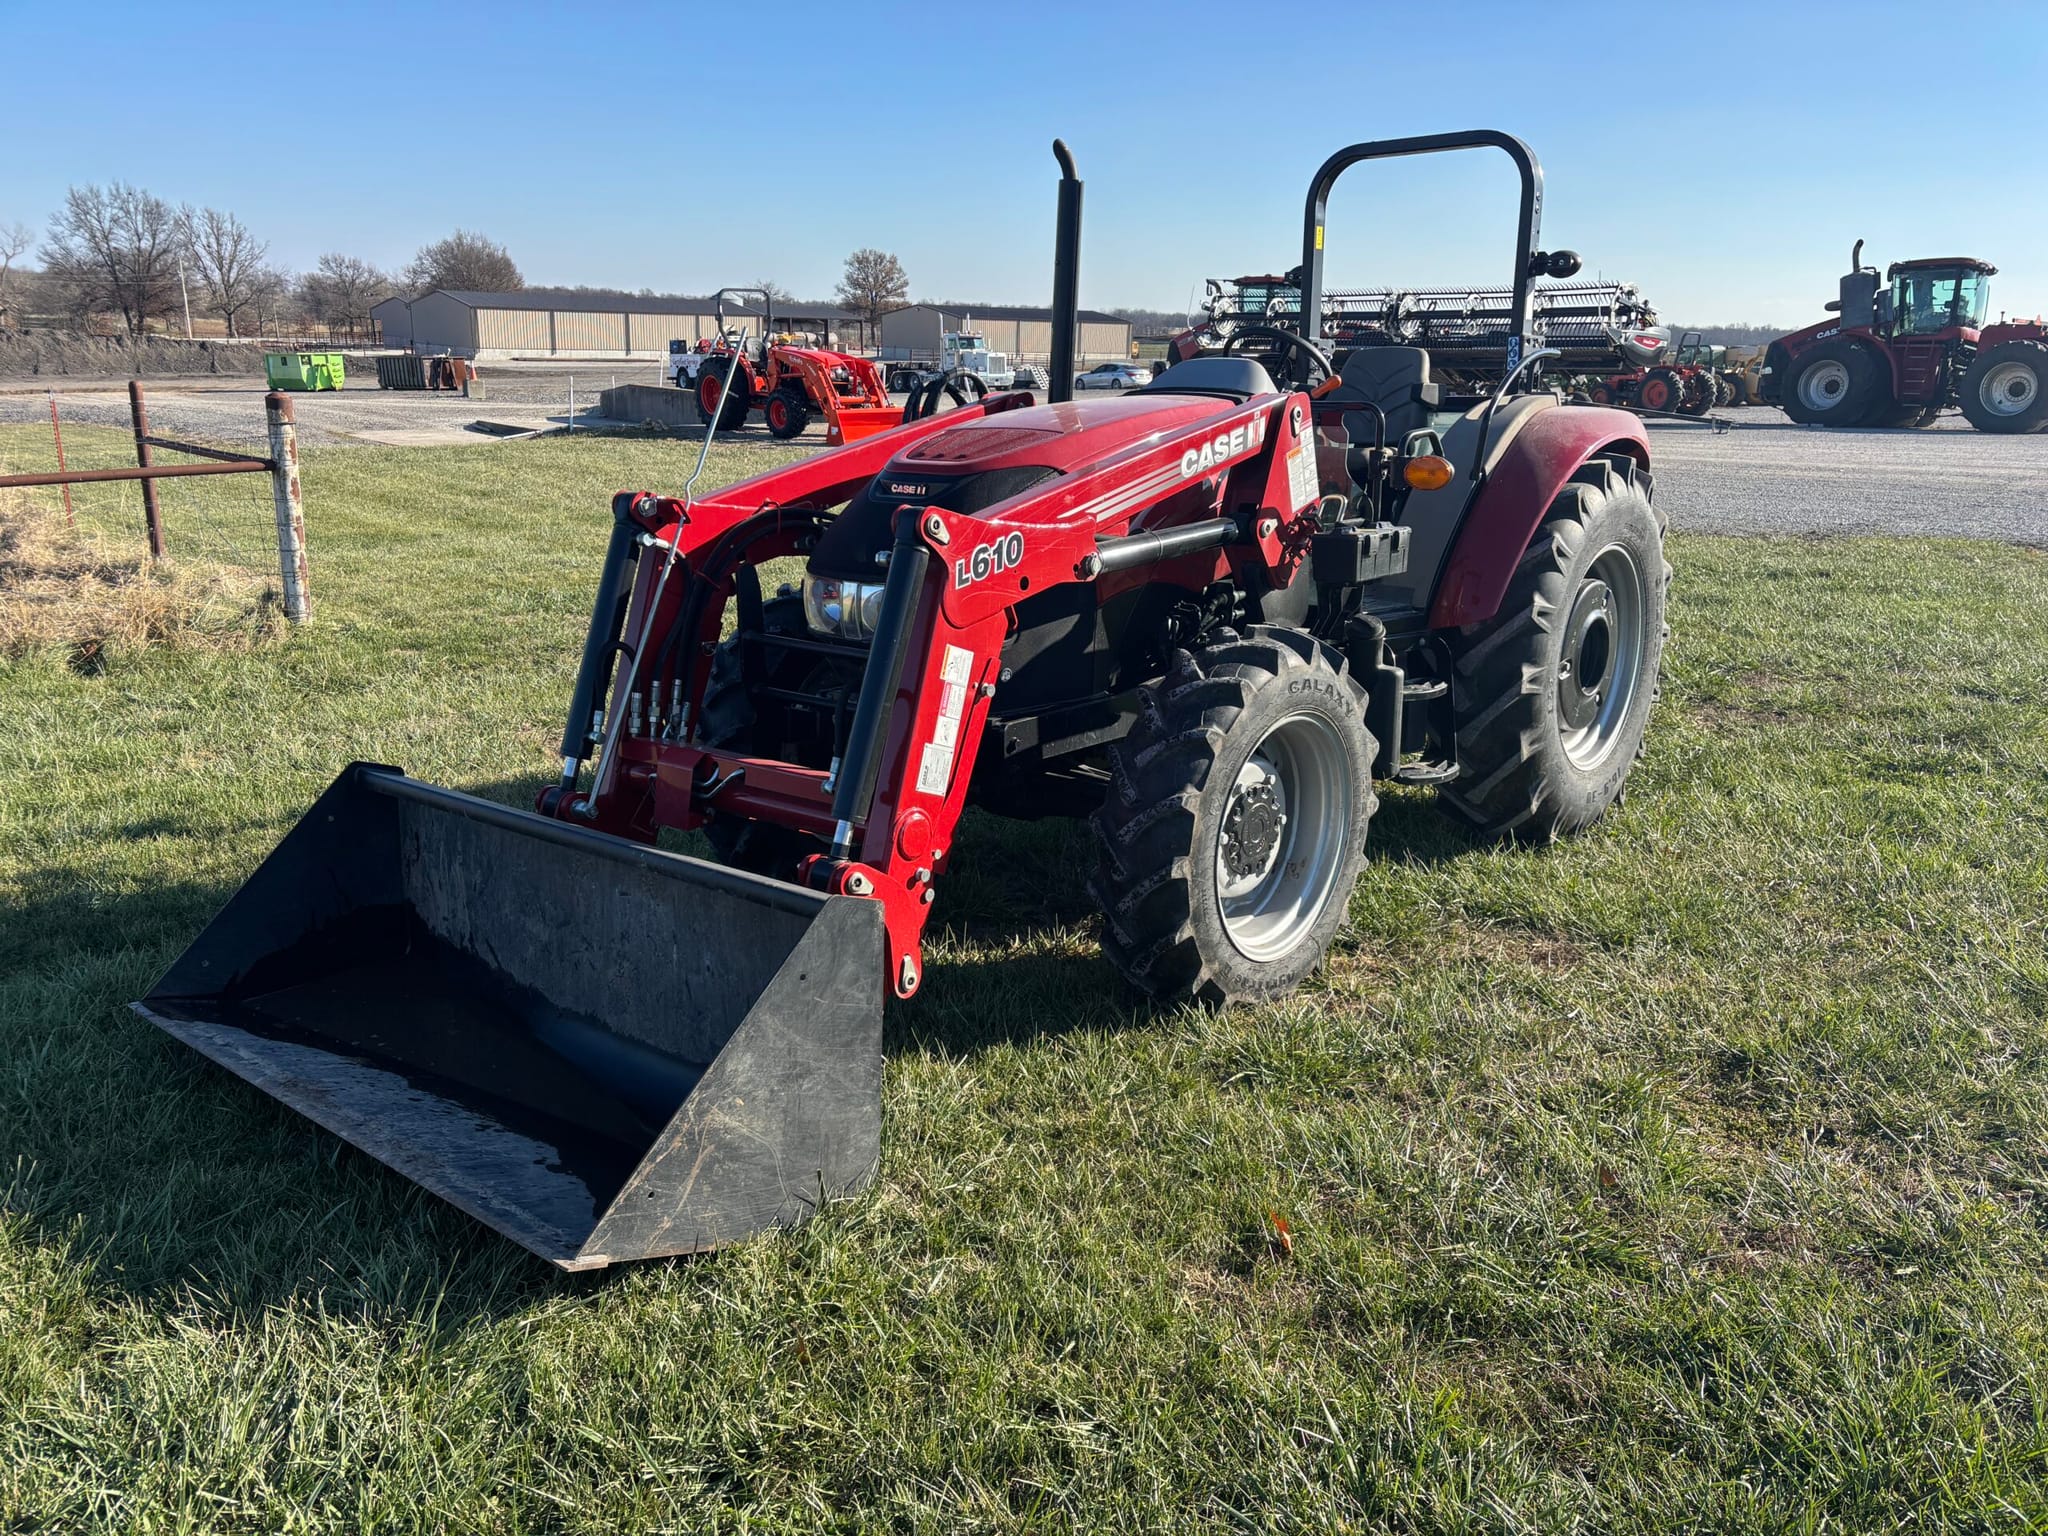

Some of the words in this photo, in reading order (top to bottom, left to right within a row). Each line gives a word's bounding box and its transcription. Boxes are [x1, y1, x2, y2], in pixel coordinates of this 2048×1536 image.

[1181, 425, 1245, 478] CASE
[891, 483, 916, 495] CASE
[955, 531, 1024, 590] L610
[1288, 679, 1354, 718] GALAXY
